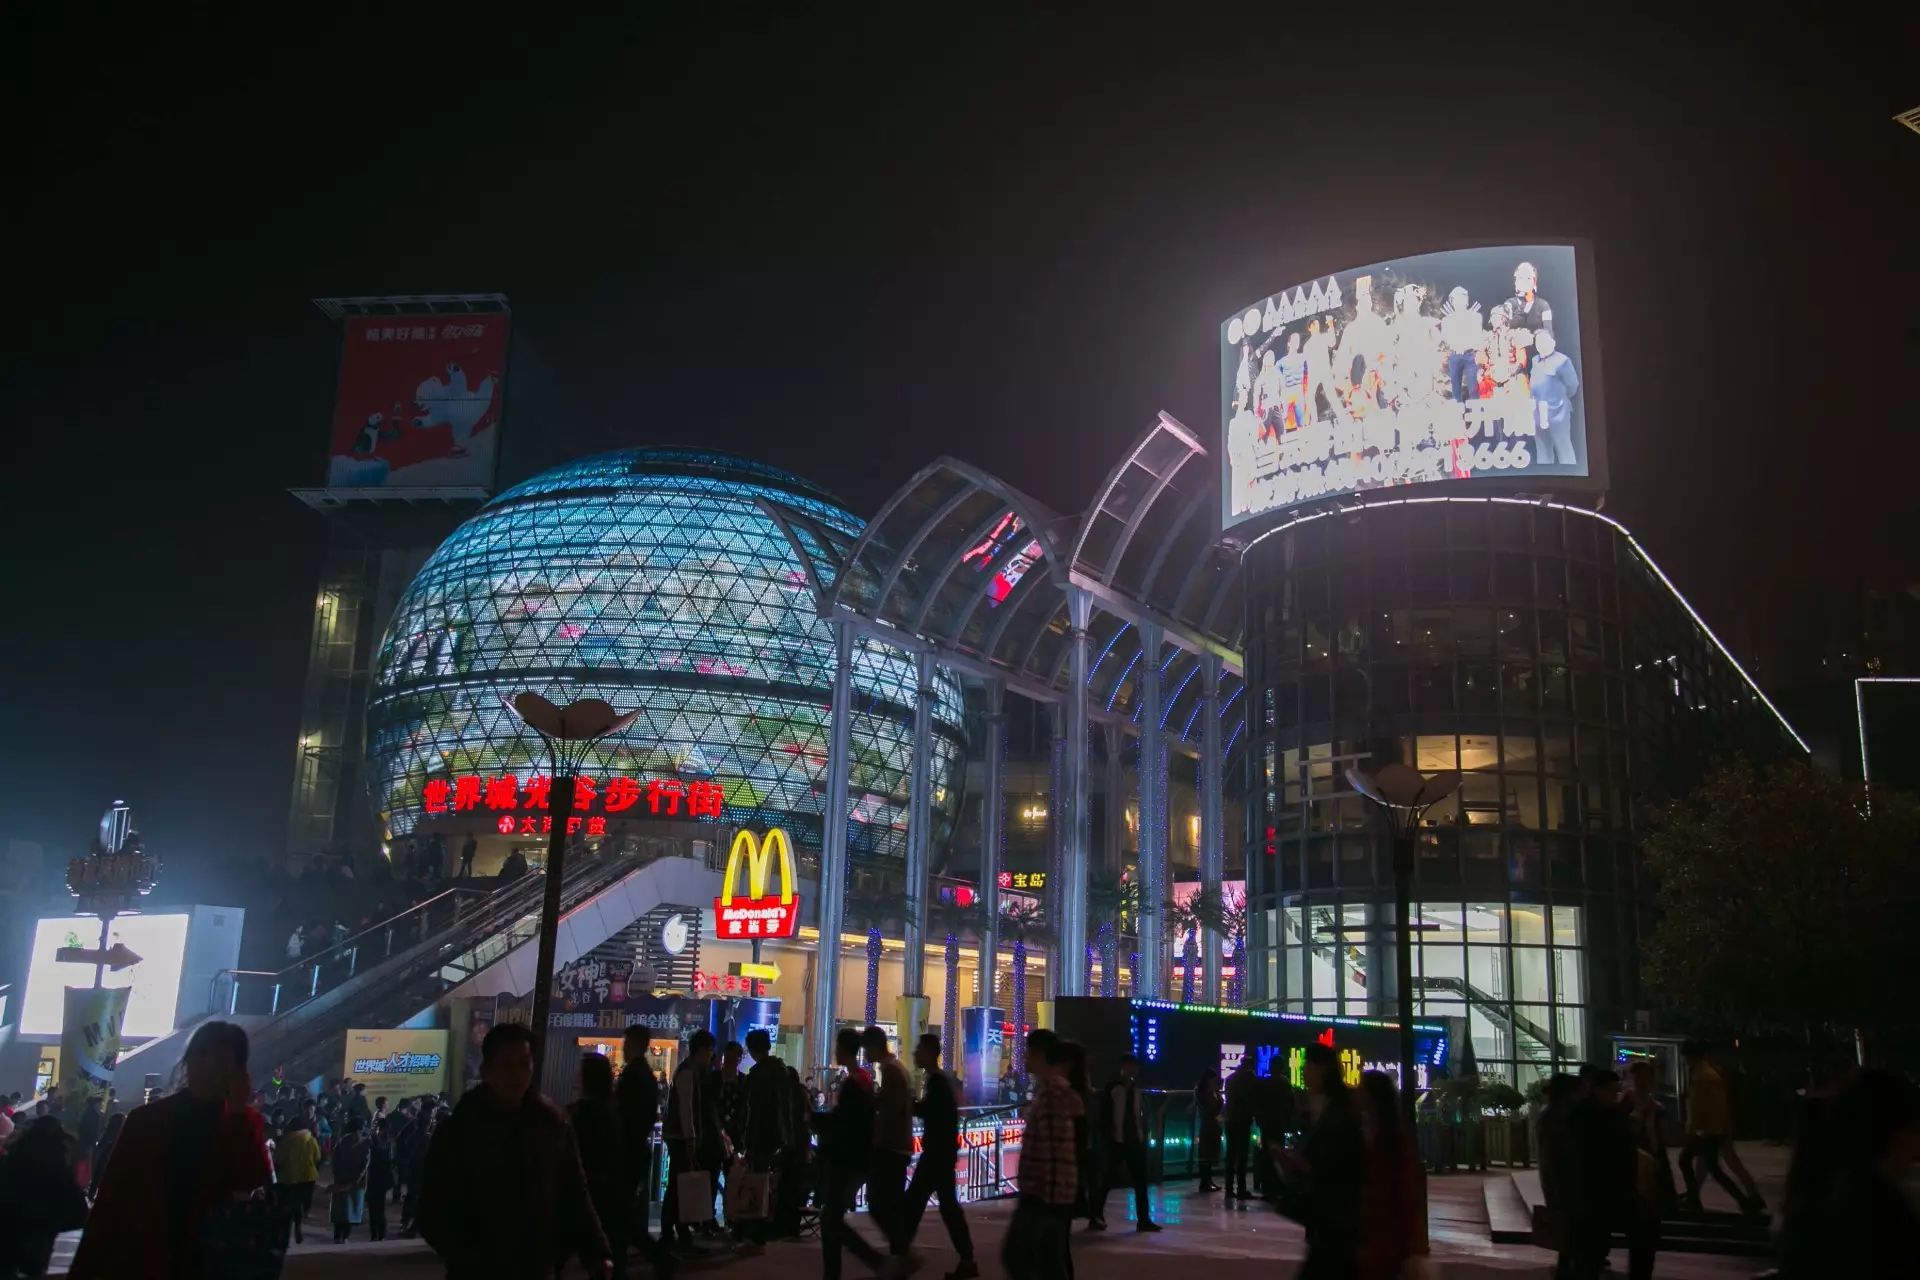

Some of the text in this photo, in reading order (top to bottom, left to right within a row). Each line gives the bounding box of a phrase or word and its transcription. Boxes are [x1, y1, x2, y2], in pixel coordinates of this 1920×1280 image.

[423, 774, 726, 818] 世界城光谷步行街
[1013, 872, 1045, 888] 宝岛
[722, 907, 787, 920] McDonald's
[728, 919, 780, 934] 麦当劳
